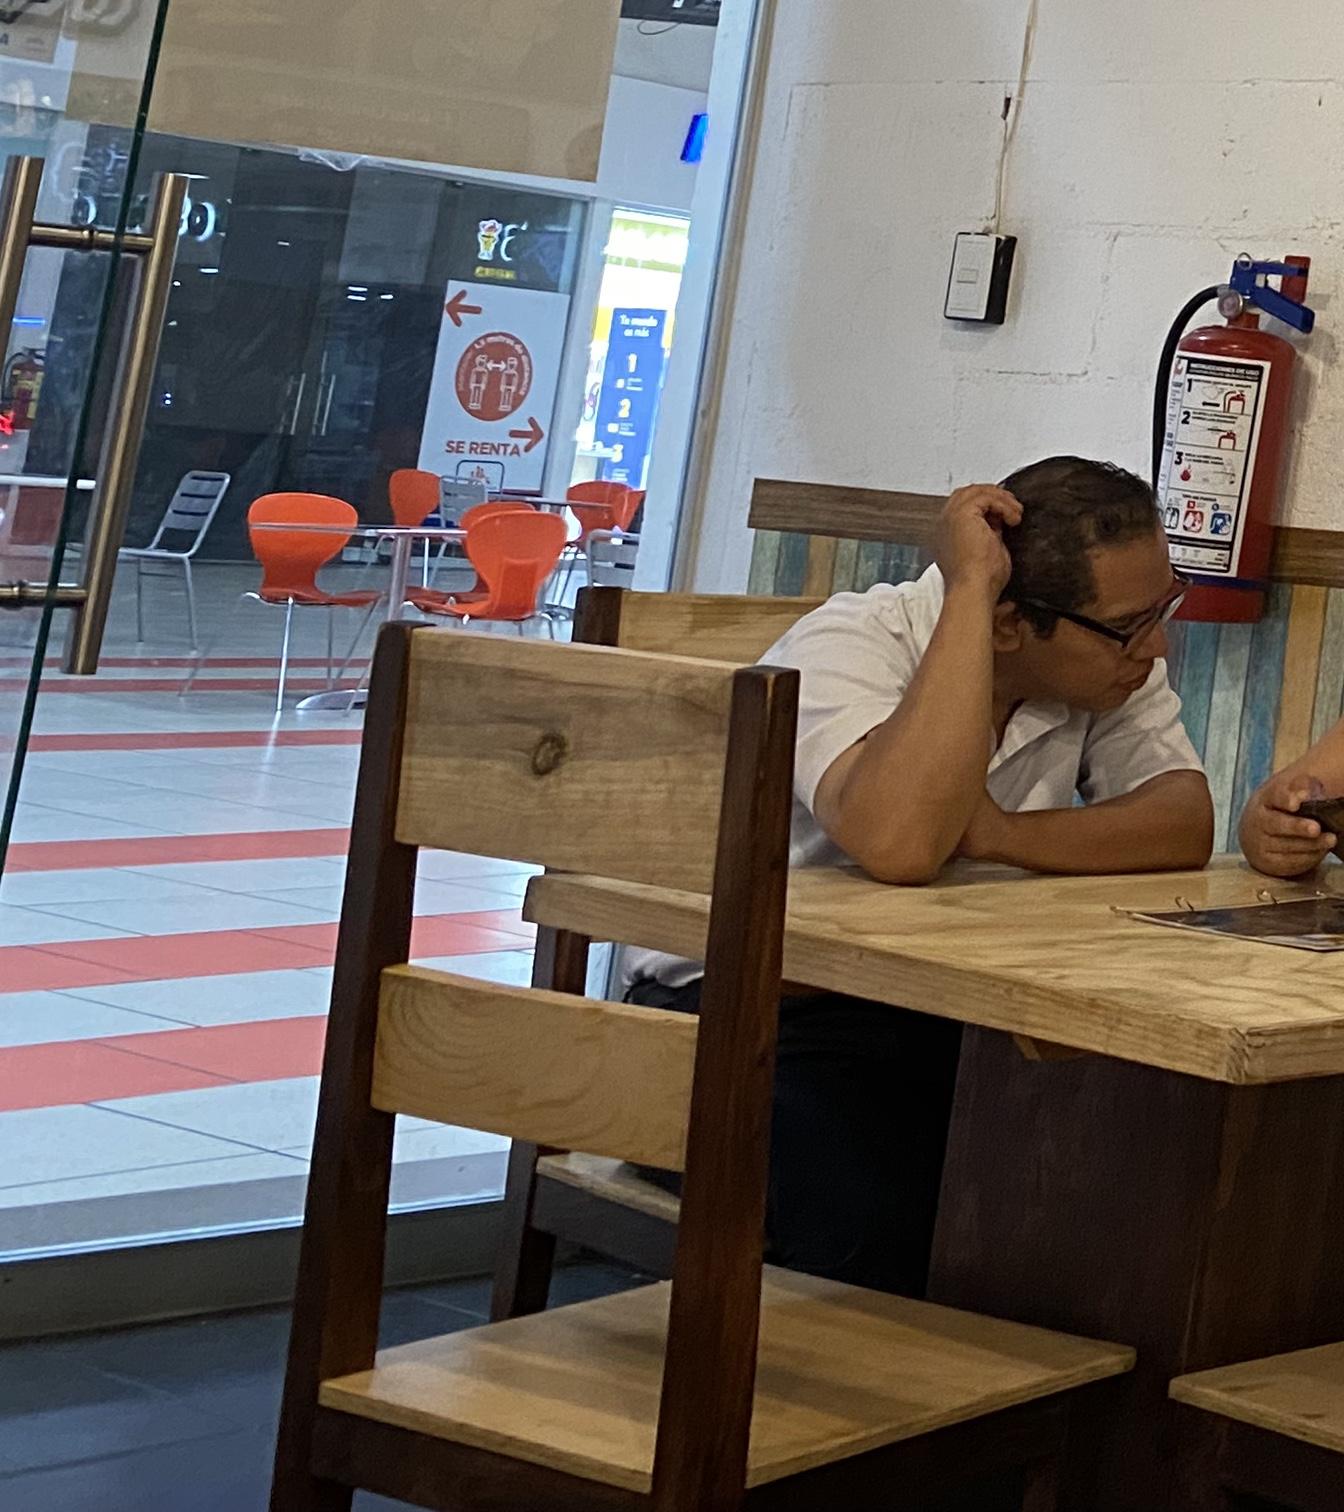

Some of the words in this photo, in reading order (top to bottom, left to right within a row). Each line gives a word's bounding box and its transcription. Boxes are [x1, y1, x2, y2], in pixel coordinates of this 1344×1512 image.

[628, 353, 637, 373] 1
[1187, 378, 1192, 392] 1
[618, 398, 631, 418] 2
[1181, 410, 1191, 425] 2
[445, 440, 466, 454] SE
[469, 441, 521, 457] RENTA
[1174, 451, 1184, 465] 3
